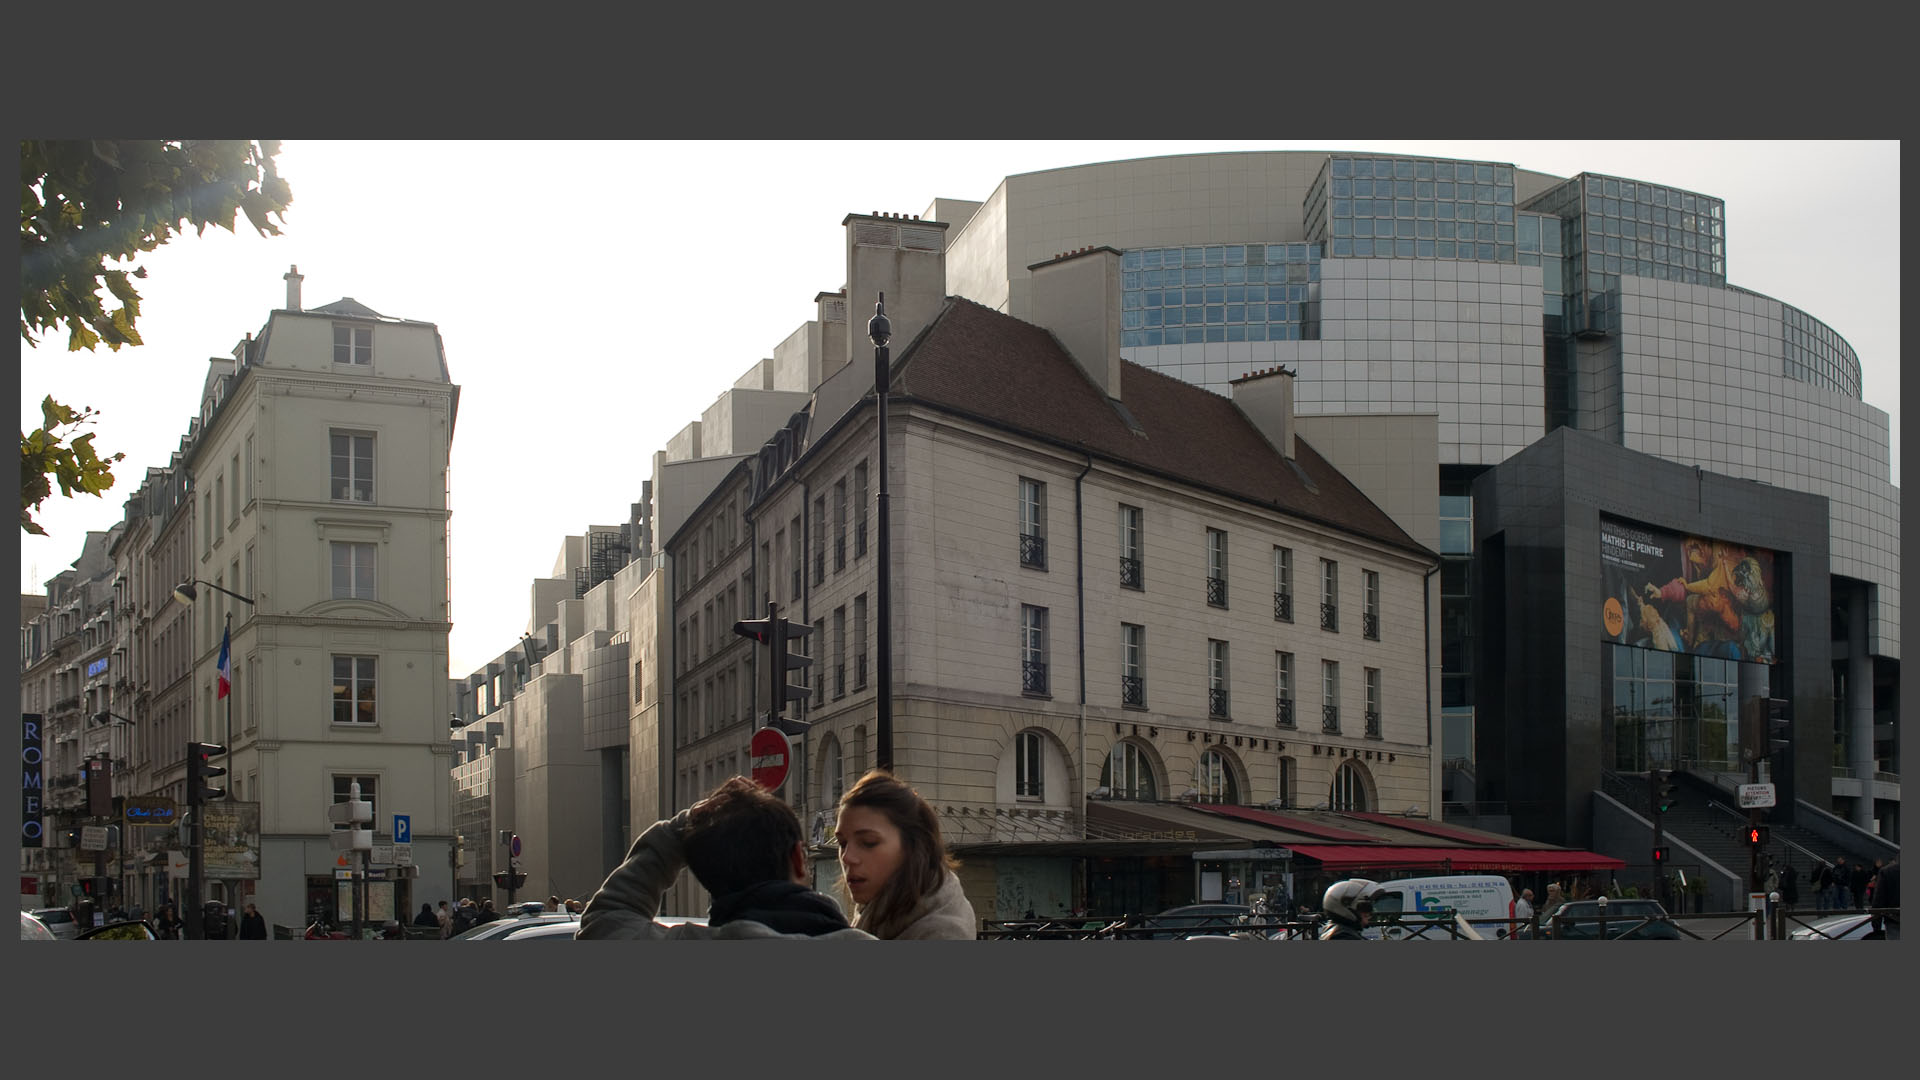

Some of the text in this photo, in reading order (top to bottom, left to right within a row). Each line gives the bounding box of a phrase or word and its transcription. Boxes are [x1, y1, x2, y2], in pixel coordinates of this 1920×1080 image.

[1601, 521, 1629, 539] MATTHIAS
[1601, 532, 1664, 558] MATHIS LE PEINTRE
[1601, 543, 1633, 560] HINDEMITH
[1187, 731, 1286, 751] GRANDES
[22, 721, 42, 839] ROMEO
[398, 819, 407, 839] P
